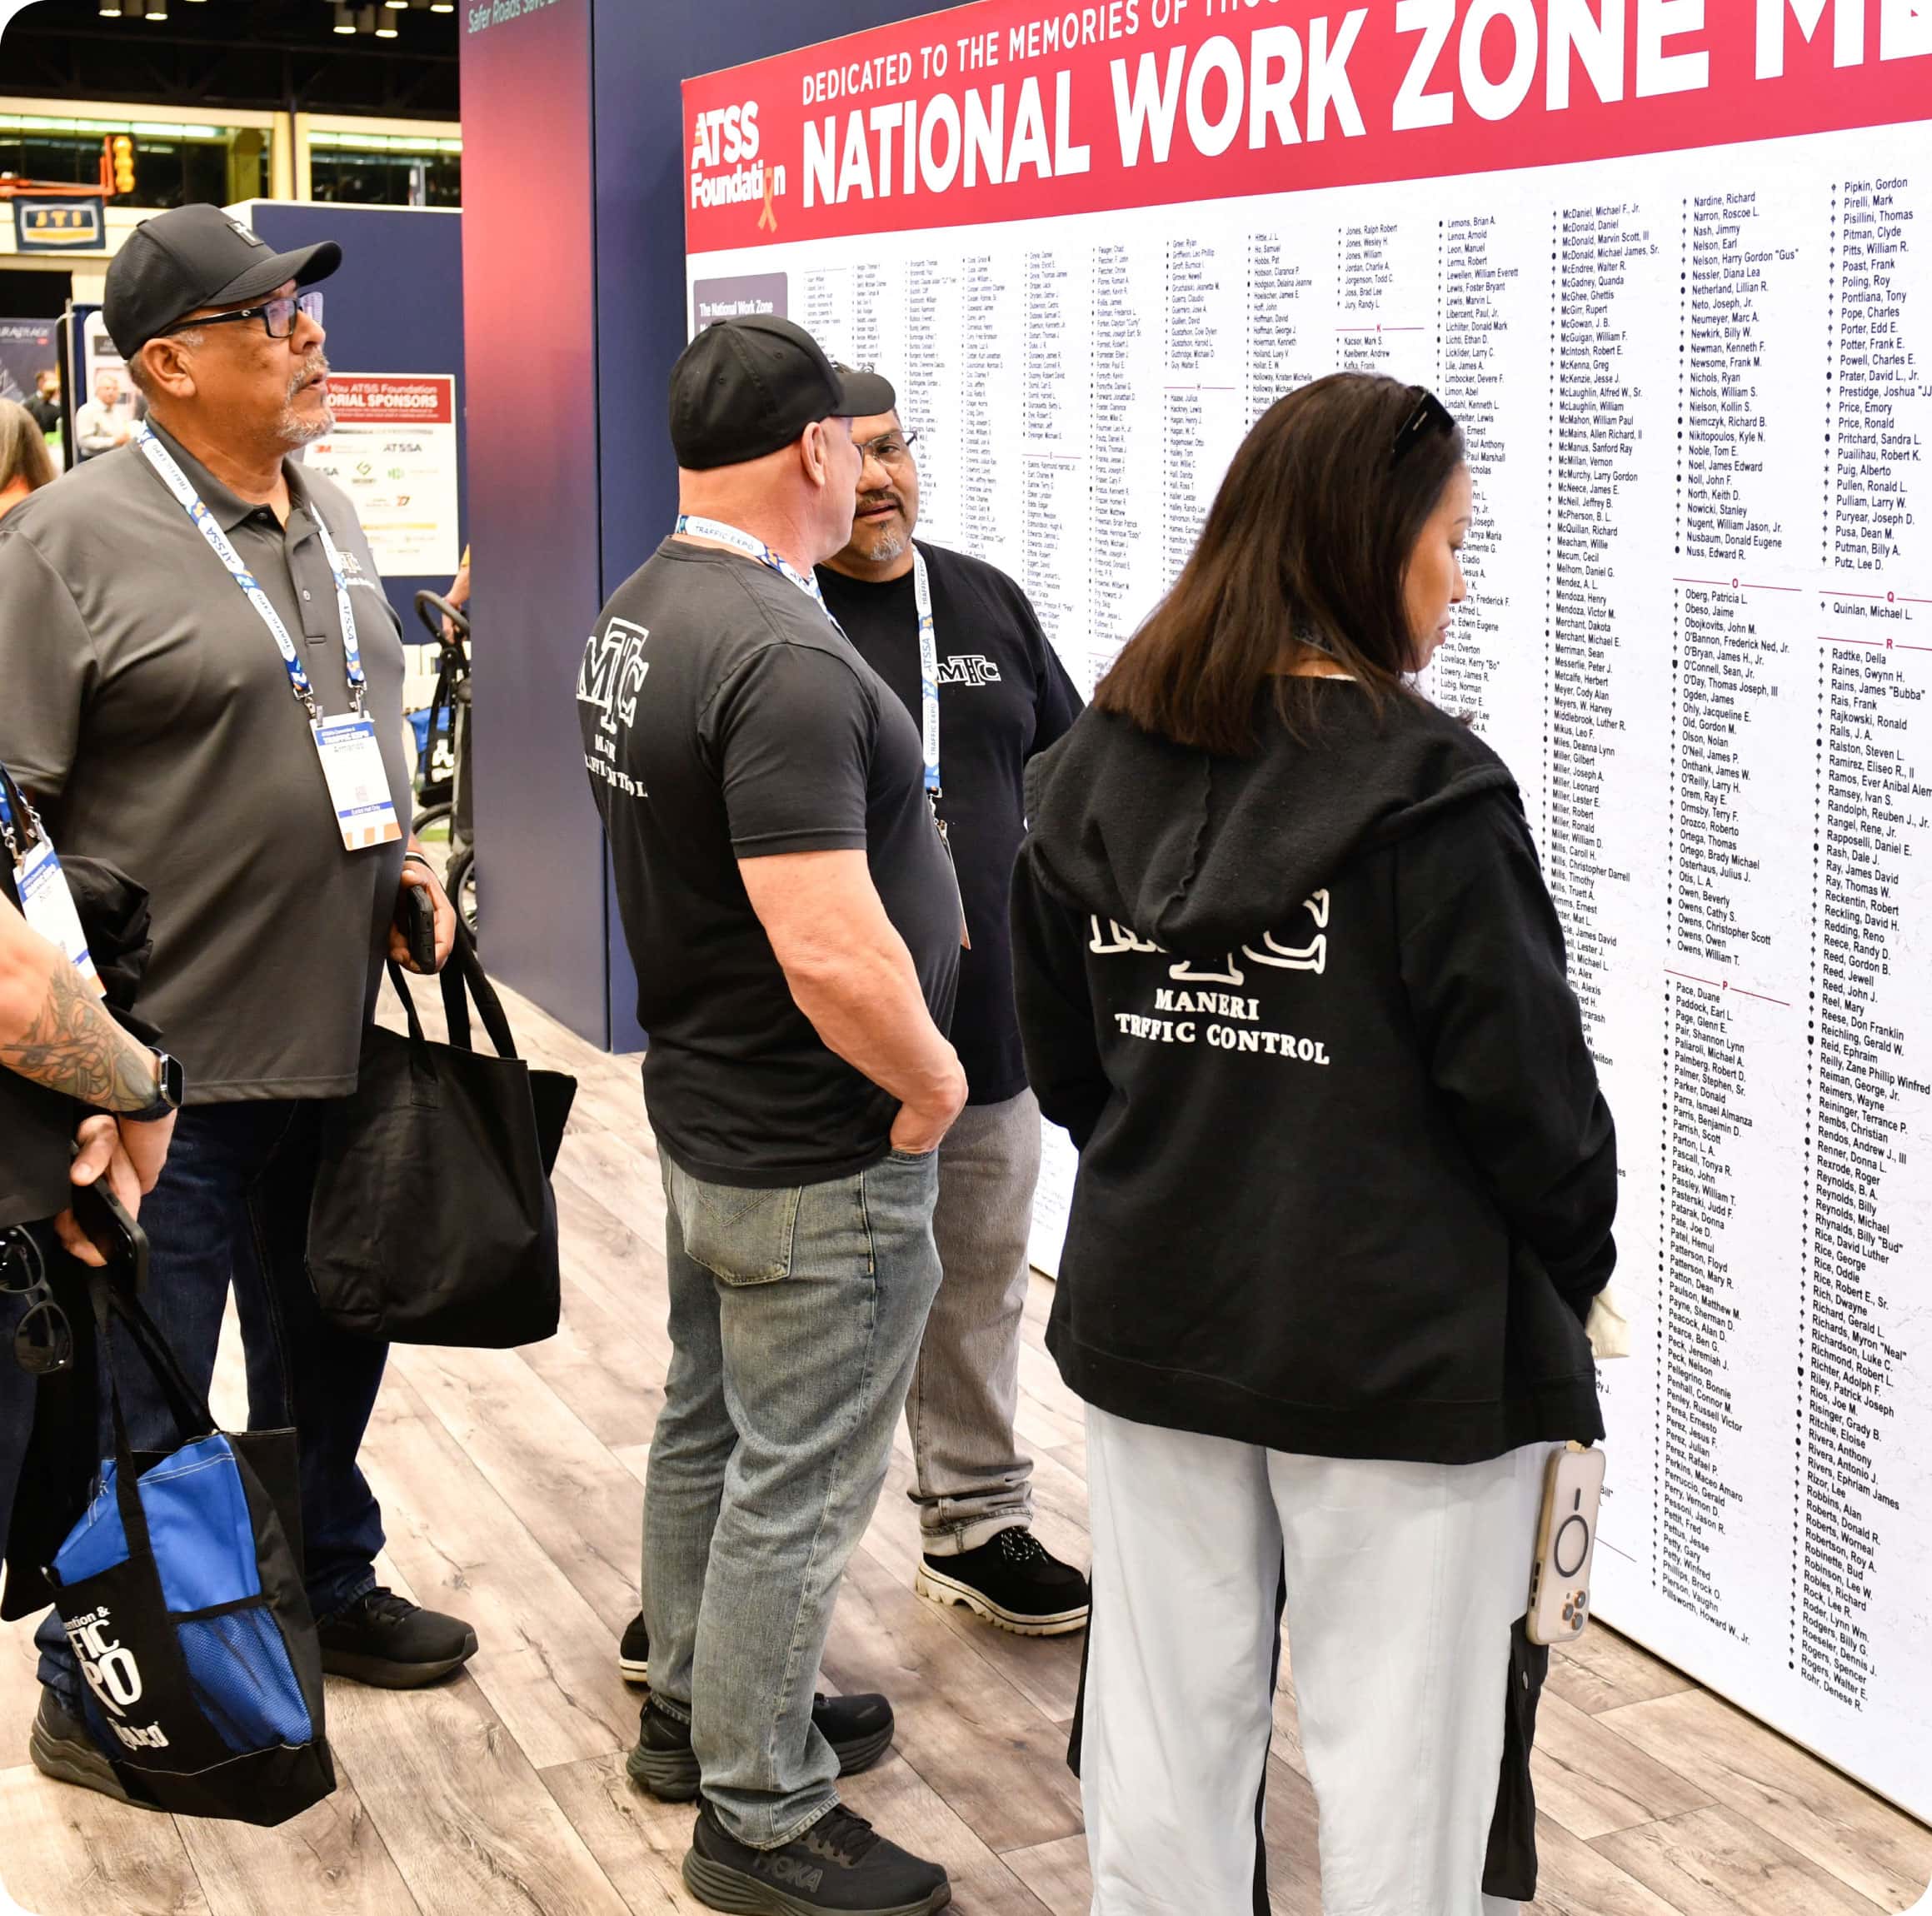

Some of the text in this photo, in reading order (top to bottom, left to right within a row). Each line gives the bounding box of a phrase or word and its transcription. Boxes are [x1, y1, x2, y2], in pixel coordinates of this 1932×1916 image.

[802, 0, 1188, 106] DEDICATED TO THE MEMORIES OF
[803, 69, 1091, 208] NATIONAL
[1109, 7, 1370, 167] WORK
[1392, 0, 1710, 132] ZONE
[691, 100, 760, 170] ATSS
[1845, 177, 1908, 195] Pipkin, Gordon
[1694, 191, 1755, 207] Nardine, Richard
[1844, 210, 1914, 225] Pisillini, Thomas
[1693, 224, 1740, 237] Nash, Jimmy
[1843, 226, 1902, 241] Pitman, Clyde
[1843, 240, 1909, 257] Pitts, William R.
[1842, 257, 1895, 272] Poast, Frank
[1842, 274, 1890, 290] Poling, Roy
[1691, 328, 1722, 339] Newkirk,
[1724, 327, 1741, 341] Billy
[382, 383, 437, 394] Foundation
[367, 395, 438, 408] SPONSORS
[1838, 417, 1895, 430] Price, Ronald
[1837, 463, 1891, 478] Puig, Alberto
[1686, 546, 1706, 558] Nuss,
[1709, 546, 1736, 560] Edward
[1835, 556, 1884, 571] Putz, Lee D.
[1887, 591, 1895, 603] Q
[1685, 602, 1735, 618] Obeso, Jaime
[1833, 601, 1913, 621] Quinlan, Michael L.
[1886, 638, 1893, 650] R
[1832, 647, 1886, 665] Radtke, Della
[1683, 687, 1735, 706] Ogden, James
[1830, 708, 1908, 731] Rajkowski, Ronald
[1680, 814, 1740, 836] Orozco, Roberto
[1827, 814, 1897, 838] Rangel, Rene, Jr.
[1824, 948, 1891, 976] Reed, Gordon B.
[1676, 981, 1720, 1004] Pace, Duane
[1155, 987, 1260, 1020] MANERI
[1822, 992, 1865, 1017] Reel, Mary
[1206, 1023, 1330, 1065] CONTROL
[1820, 1036, 1878, 1064] Reid, Ephraim
[1820, 1080, 1885, 1112] Reimers, Wayne
[1672, 1159, 1715, 1185] Pasko, John
[1670, 1267, 1715, 1295] Patton, Dean
[1813, 1284, 1868, 1316] Rich, Dwayne
[1809, 1413, 1866, 1449] Ritchie, Eloise
[1806, 1484, 1862, 1521] Robbins, Alan
[1663, 1533, 1700, 1564] Petty, Gary
[1662, 1572, 1719, 1613] Pierson, Vaughn
[97, 1605, 112, 1618] &
[1801, 1639, 1867, 1685] Rogers, Spencer
[1800, 1666, 1863, 1713] Rohr, Denese R.
